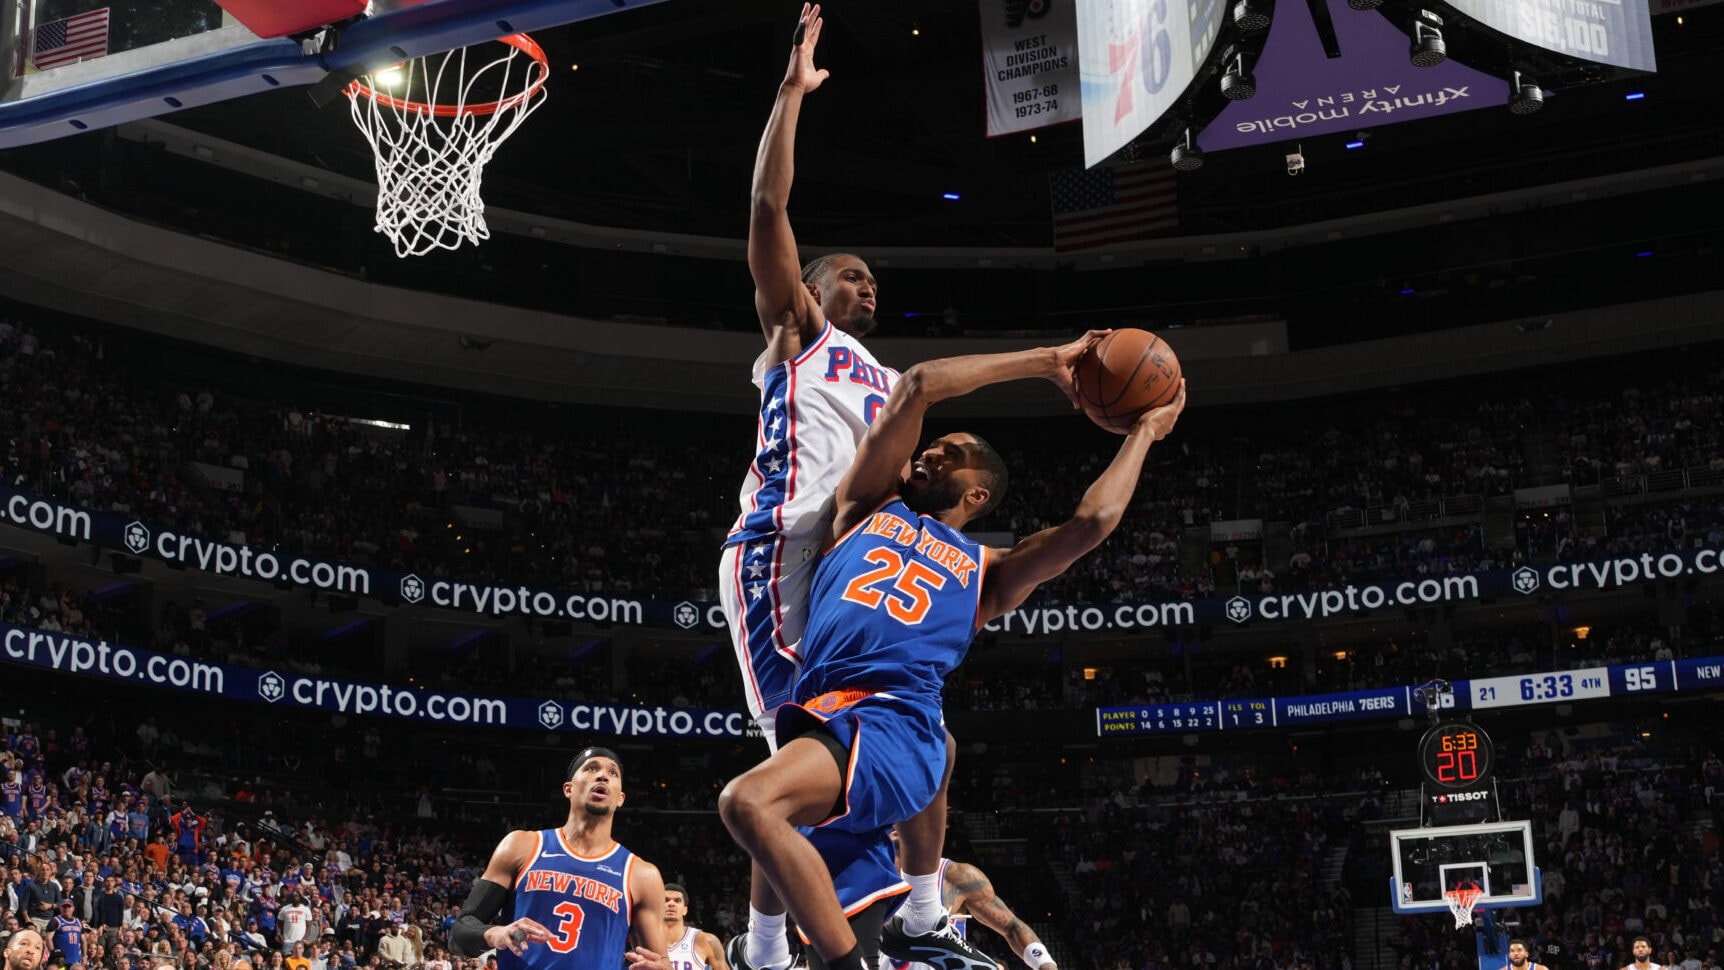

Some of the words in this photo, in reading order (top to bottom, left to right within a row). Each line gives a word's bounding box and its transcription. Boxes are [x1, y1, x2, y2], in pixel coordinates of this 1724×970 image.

[1006, 46, 1058, 67] DIVISION
[1014, 35, 1047, 52] WEST
[998, 56, 1069, 82] CHAMPIONS
[1012, 84, 1058, 105] 1967-68
[1292, 84, 1401, 110] ARENA
[1359, 86, 1470, 114] xfinity
[1014, 99, 1058, 119] 1973-74
[1236, 105, 1350, 134] mobile
[157, 531, 370, 594] crypto.com
[861, 512, 918, 547] NEW
[915, 526, 978, 590] YORK
[1547, 550, 1724, 588] crypto.c
[842, 546, 947, 625] 25
[1258, 572, 1480, 620] crypto.com
[432, 581, 643, 624] crypto.com
[5, 629, 224, 694] crypto.com
[1696, 665, 1721, 680] NEW
[1480, 687, 1496, 700] 21
[1520, 674, 1574, 701] 6:33
[1581, 677, 1601, 690] 4TH
[1624, 667, 1656, 691] 95
[292, 677, 507, 724] crypto.com
[1103, 711, 1136, 720] PLAYER
[1141, 710, 1149, 719] 0
[1189, 707, 1196, 716] 9
[1203, 706, 1214, 715] 25
[1250, 702, 1266, 710] TOL
[1287, 700, 1355, 717] PHILADELPHIA
[1358, 696, 1395, 711] 76ERS
[1104, 722, 1136, 731] POINTS
[1141, 721, 1151, 730] 14
[1173, 719, 1182, 728] 15
[1188, 718, 1199, 727] 22
[1206, 717, 1212, 726] 2
[1255, 712, 1263, 725] 3
[1442, 733, 1477, 751] 6:33
[1437, 750, 1477, 782] 20
[1447, 791, 1488, 802] TISSOT
[526, 870, 572, 894] NEW
[573, 875, 623, 914] YORK
[547, 901, 585, 954] 3
